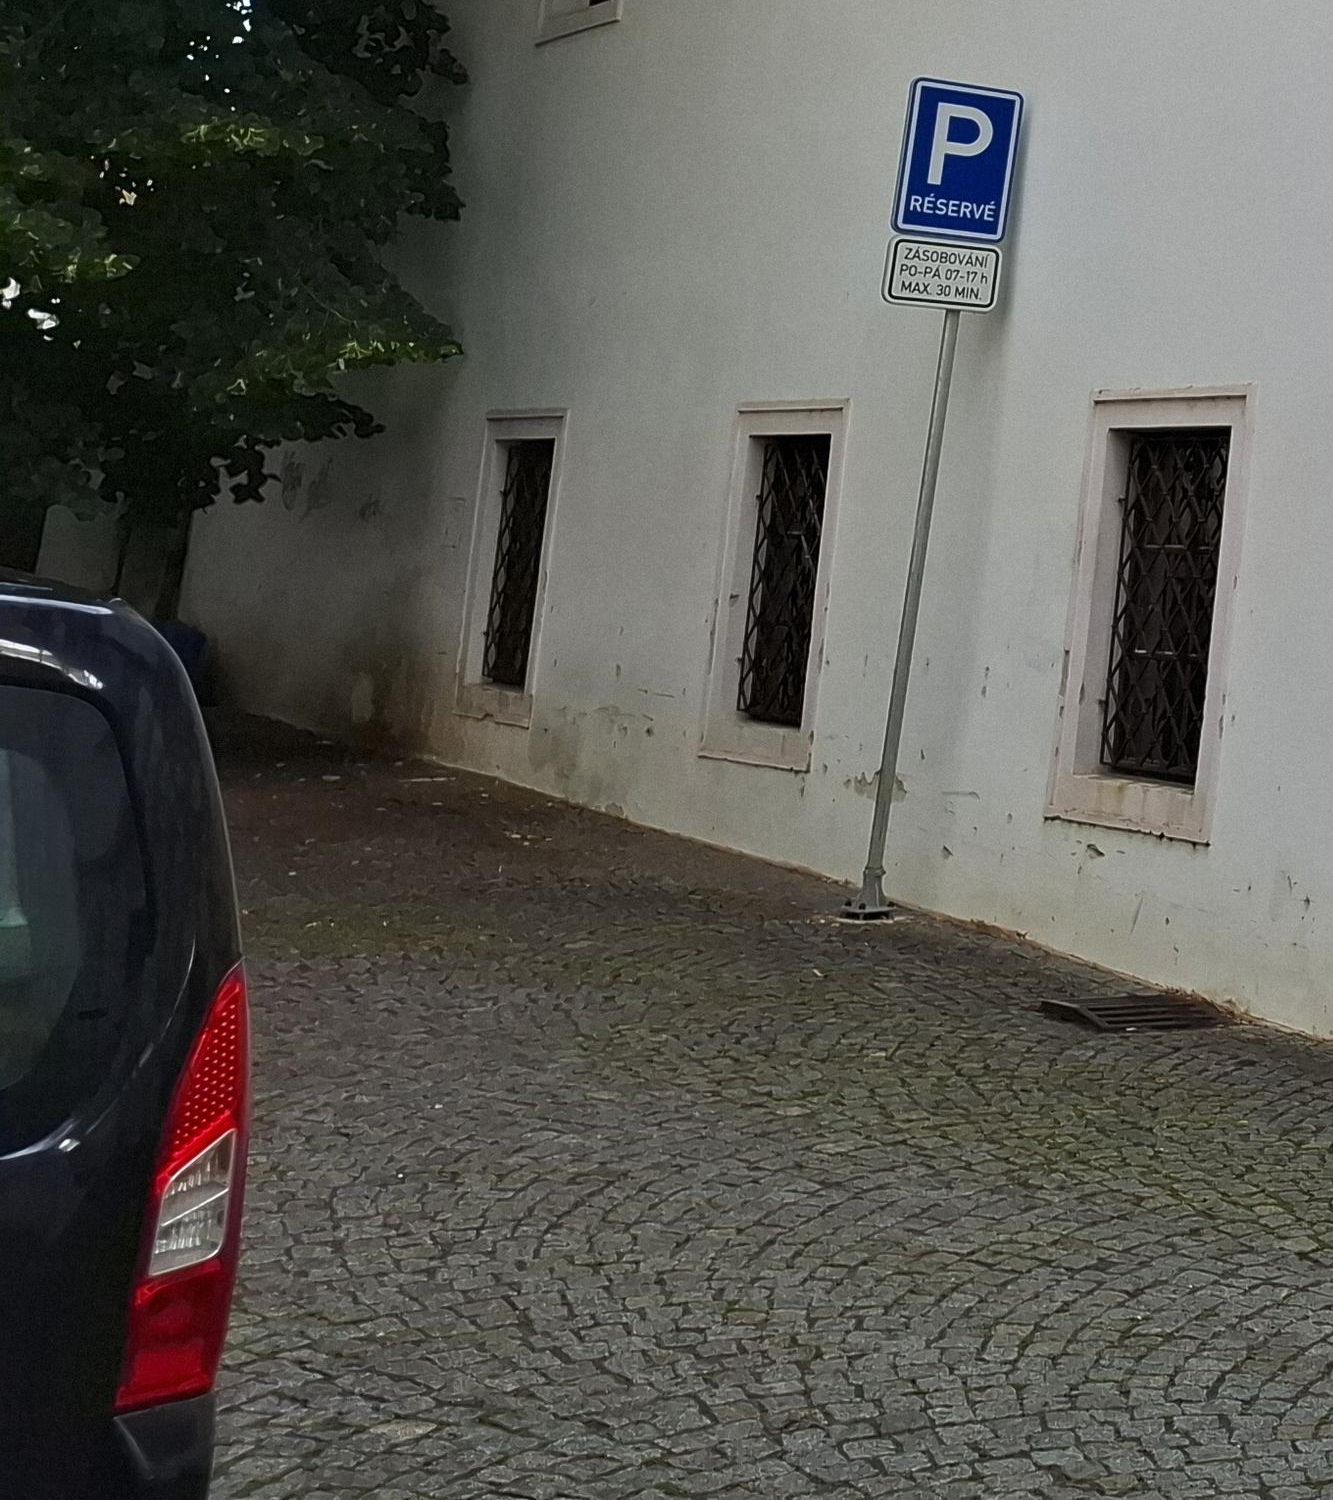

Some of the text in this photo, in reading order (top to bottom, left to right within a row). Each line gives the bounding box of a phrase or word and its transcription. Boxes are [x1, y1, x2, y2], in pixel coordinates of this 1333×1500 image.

[927, 102, 993, 185] P
[909, 193, 996, 221] RÉSERVÉ
[904, 246, 990, 268] ZÁSOBOVÁNÍ
[899, 263, 988, 284] PO-PÁ 07-17 h
[900, 280, 982, 300] MAX. 30 MIN.
